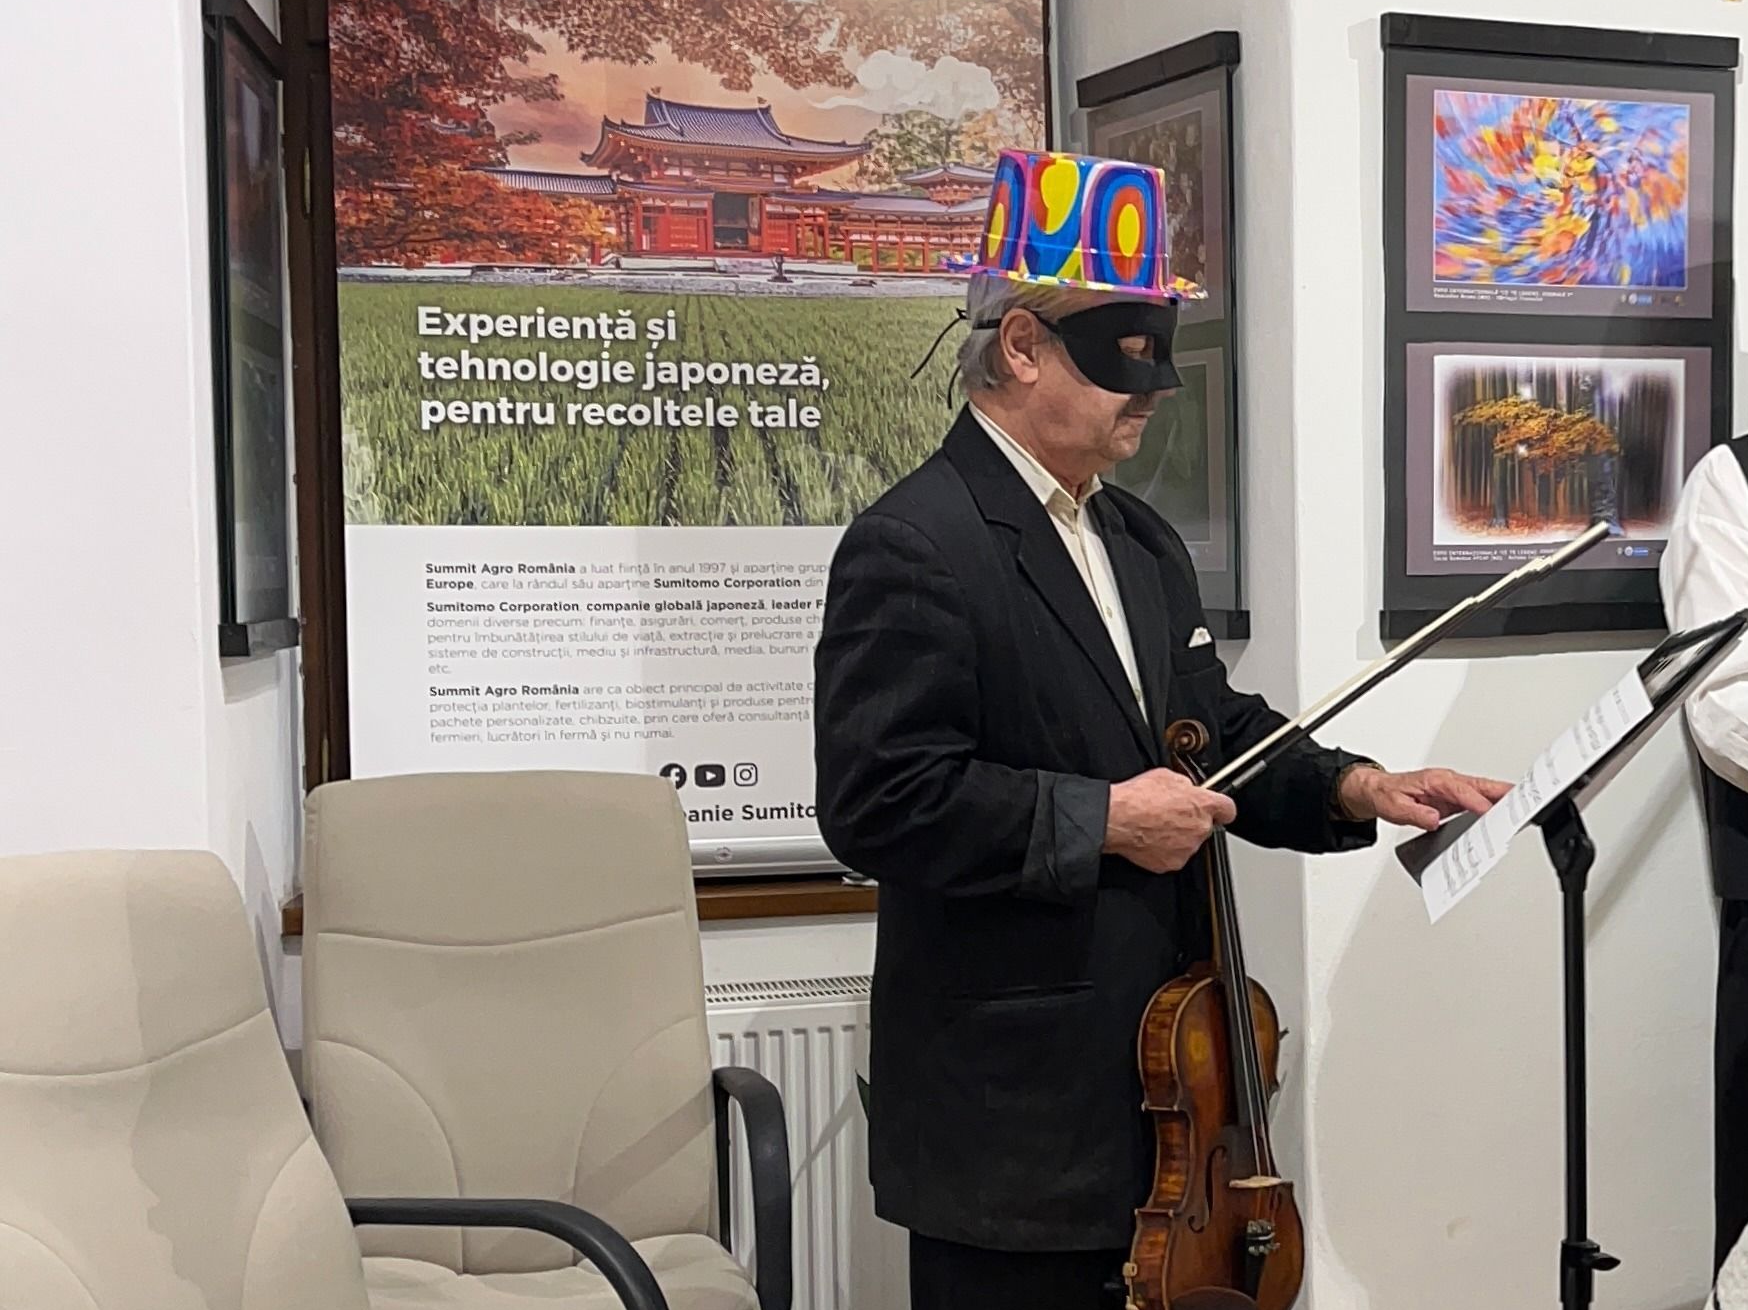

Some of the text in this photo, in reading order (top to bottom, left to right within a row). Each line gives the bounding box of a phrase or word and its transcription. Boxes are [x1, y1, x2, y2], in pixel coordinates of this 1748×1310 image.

[417, 306, 677, 349] Experiență și
[418, 350, 829, 391] tehnologie japoneză,
[421, 397, 821, 429] pentru recoltele tale
[426, 563, 476, 574] Summit
[482, 563, 513, 576] Agro
[518, 563, 575, 574] România
[580, 565, 587, 574] a
[591, 563, 613, 574] luat
[669, 563, 694, 573] anul
[699, 563, 726, 573] 1997
[798, 564, 830, 576] grup
[481, 581, 509, 589] care
[512, 579, 523, 589] la
[527, 579, 567, 589] rândul
[654, 578, 719, 588] Sumitomo
[724, 578, 801, 590] Corporation
[805, 579, 823, 588] din
[427, 602, 495, 612] Sumitomo
[587, 601, 650, 613] companie
[655, 600, 702, 613] globală
[771, 599, 811, 610] leader
[816, 600, 827, 609] F
[427, 617, 479, 628] domenii
[484, 617, 529, 627] diverse
[752, 616, 801, 626] produse
[428, 634, 470, 644] pentru
[569, 632, 608, 642] stilului
[613, 632, 628, 641] de
[741, 631, 803, 642] prelucrare
[428, 648, 477, 658] sisteme
[482, 647, 498, 658] de
[577, 647, 616, 657] mediu
[769, 646, 808, 655] bunuri
[429, 686, 480, 697] Summit
[485, 686, 517, 698] Agro
[521, 684, 579, 696] România
[583, 686, 603, 695] are
[607, 686, 622, 695] ca
[669, 683, 723, 695] principal
[747, 682, 803, 691] activitate
[723, 698, 773, 708] produse
[431, 717, 483, 728] pachete
[644, 714, 669, 725] prin
[672, 714, 699, 723] care
[487, 731, 540, 742] lucrători
[560, 728, 597, 740] fermă
[614, 729, 630, 739] nu
[683, 805, 734, 822] anie
